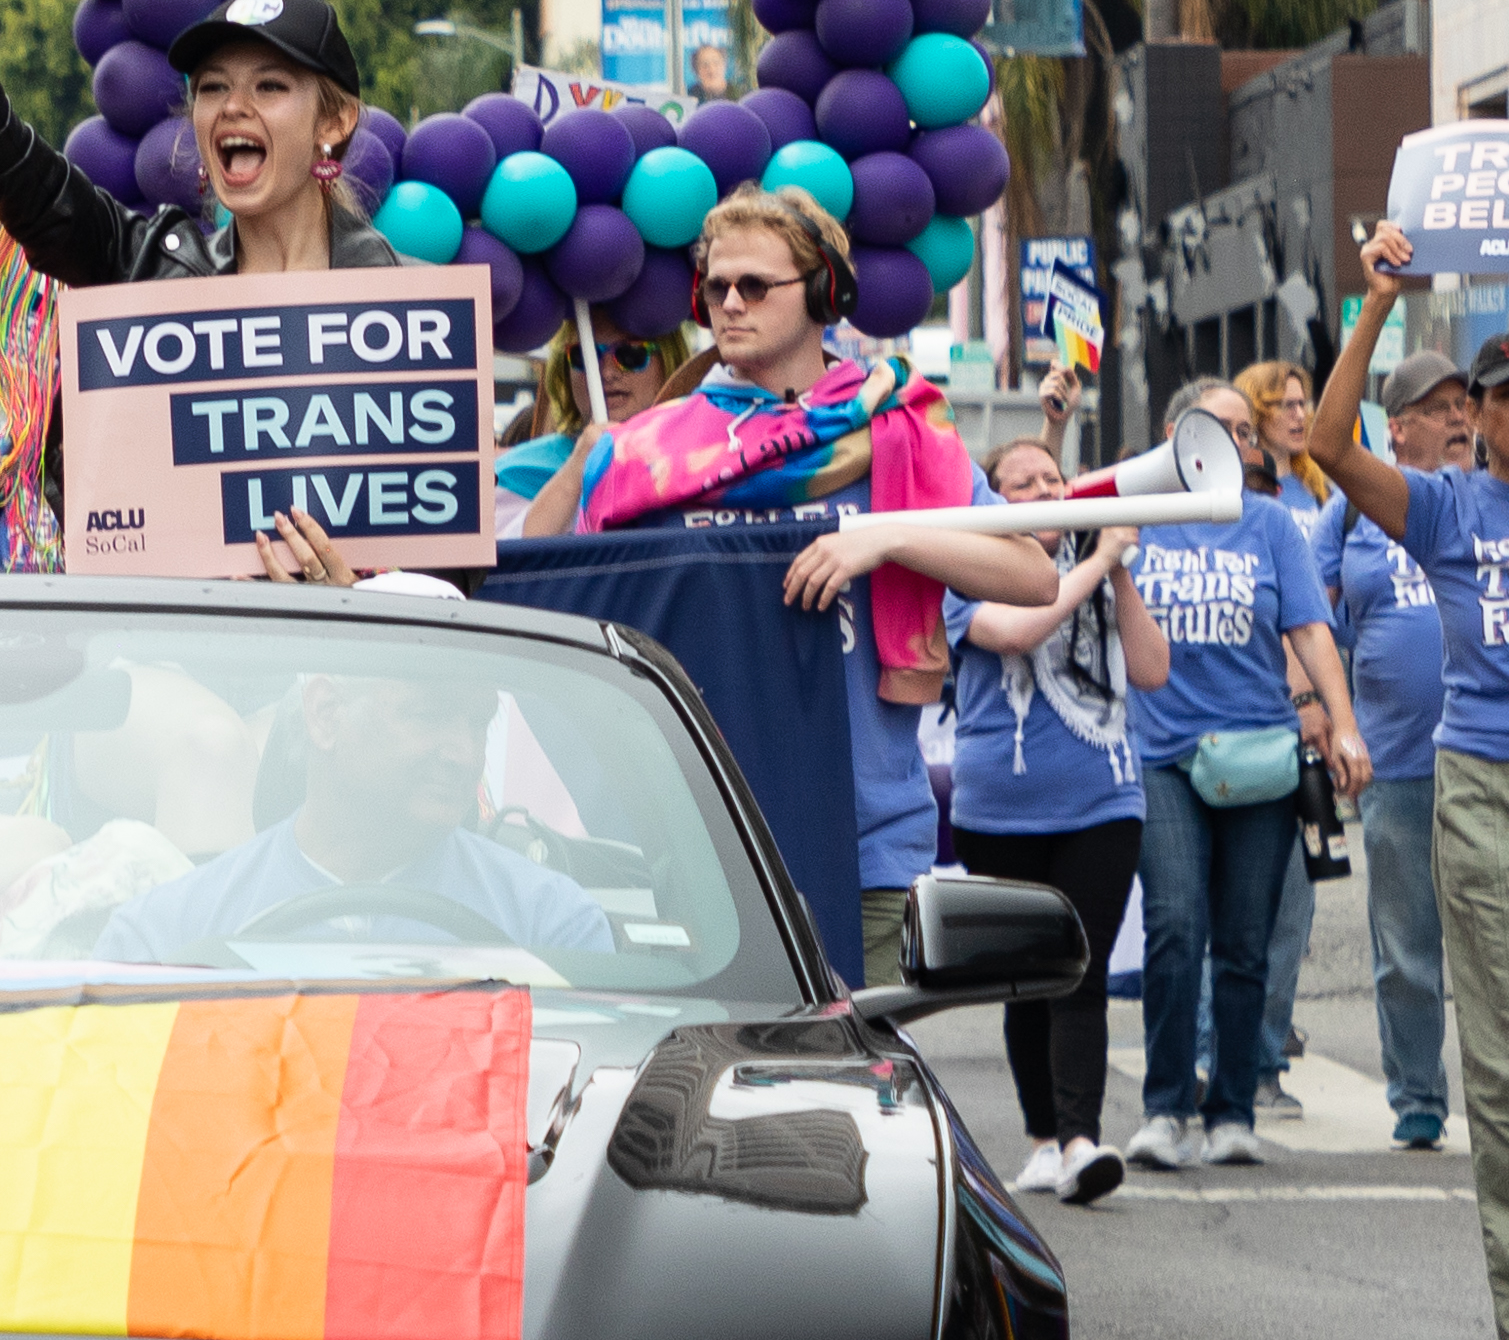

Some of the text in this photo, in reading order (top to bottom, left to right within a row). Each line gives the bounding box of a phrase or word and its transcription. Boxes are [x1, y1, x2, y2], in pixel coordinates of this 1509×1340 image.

[96, 308, 453, 379] VOTE FOR
[191, 388, 456, 455] TRANS
[247, 468, 459, 533] LIVES
[86, 507, 145, 533] ACLU
[85, 533, 146, 556] SoCal
[1213, 547, 1260, 576] For
[1134, 570, 1256, 607] Trans
